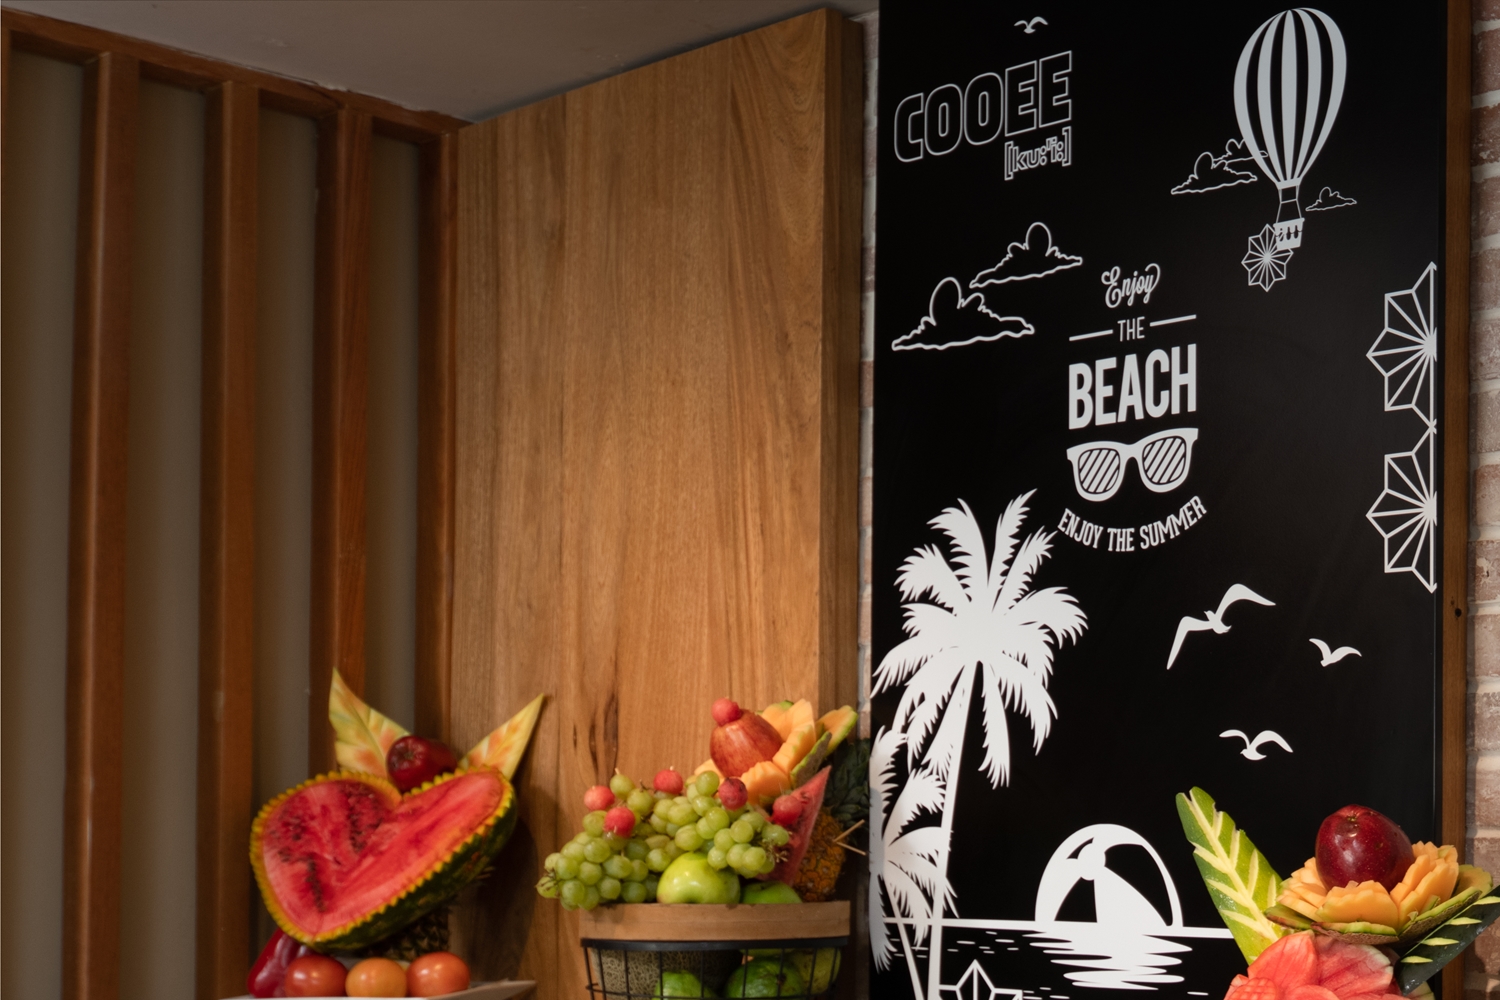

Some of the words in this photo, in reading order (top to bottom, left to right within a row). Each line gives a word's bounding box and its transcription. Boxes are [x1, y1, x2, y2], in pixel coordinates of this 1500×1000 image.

[894, 50, 1072, 162] COOEE
[1101, 263, 1160, 308] Enjoy
[1117, 316, 1145, 342] THE
[1069, 343, 1197, 430] BEACH
[1057, 508, 1104, 549] ENJOY
[1107, 528, 1135, 552] THE
[1139, 496, 1207, 549] SUMMER
